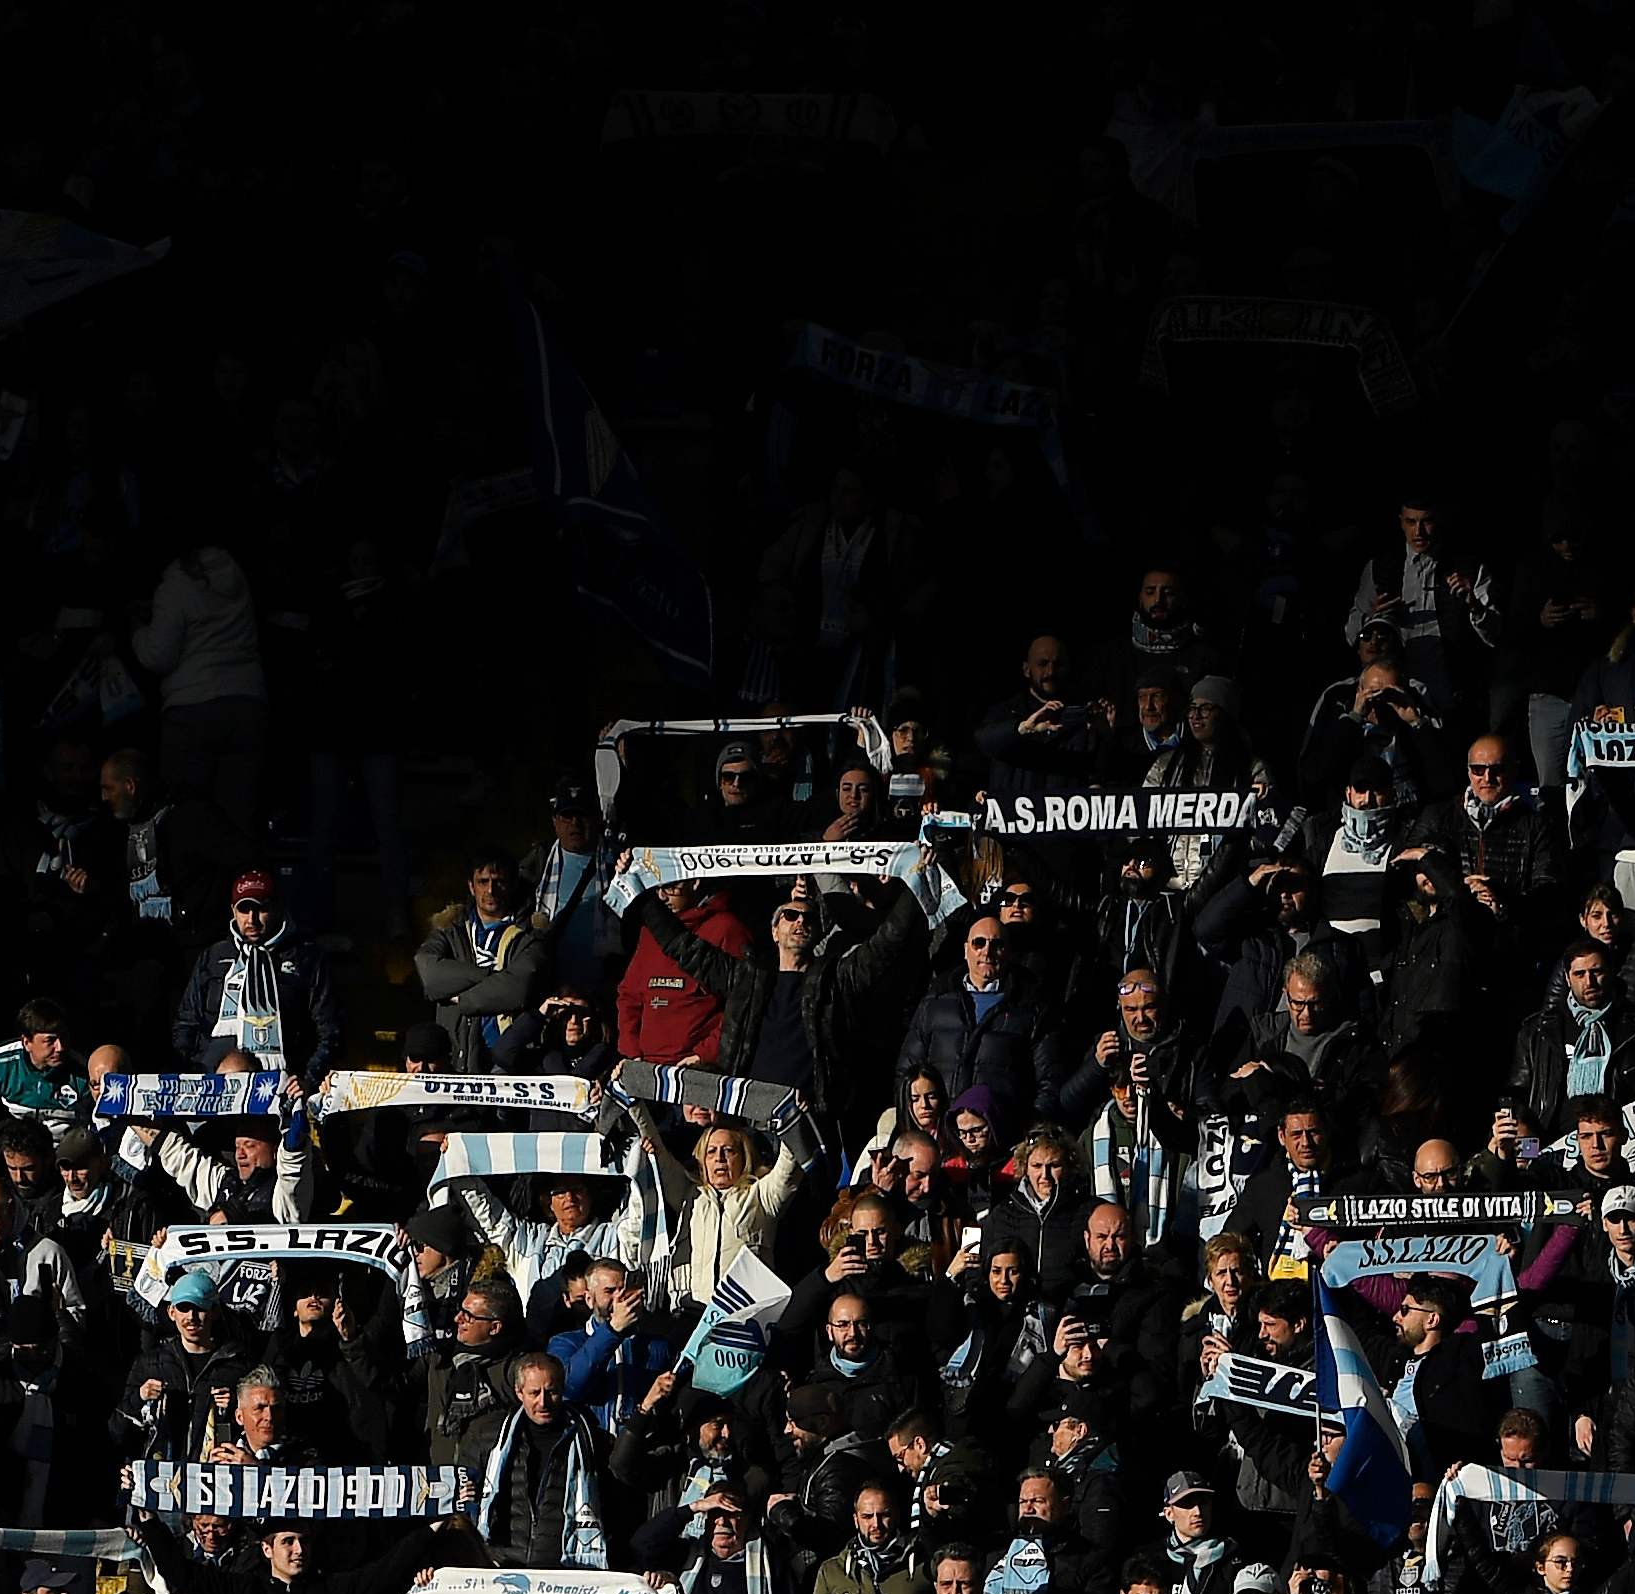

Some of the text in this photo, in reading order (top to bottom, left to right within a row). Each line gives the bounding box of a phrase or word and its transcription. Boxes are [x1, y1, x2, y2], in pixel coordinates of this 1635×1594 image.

[986, 795, 1137, 834] A.S.ROMA
[680, 853, 745, 870] 1900
[503, 1081, 556, 1099] S.S.
[1357, 1195, 1525, 1220] LAZIO STILE DI VITA
[178, 1229, 274, 1258] S.S.
[257, 1470, 327, 1512] LAZIO
[346, 1470, 407, 1511] 1900
